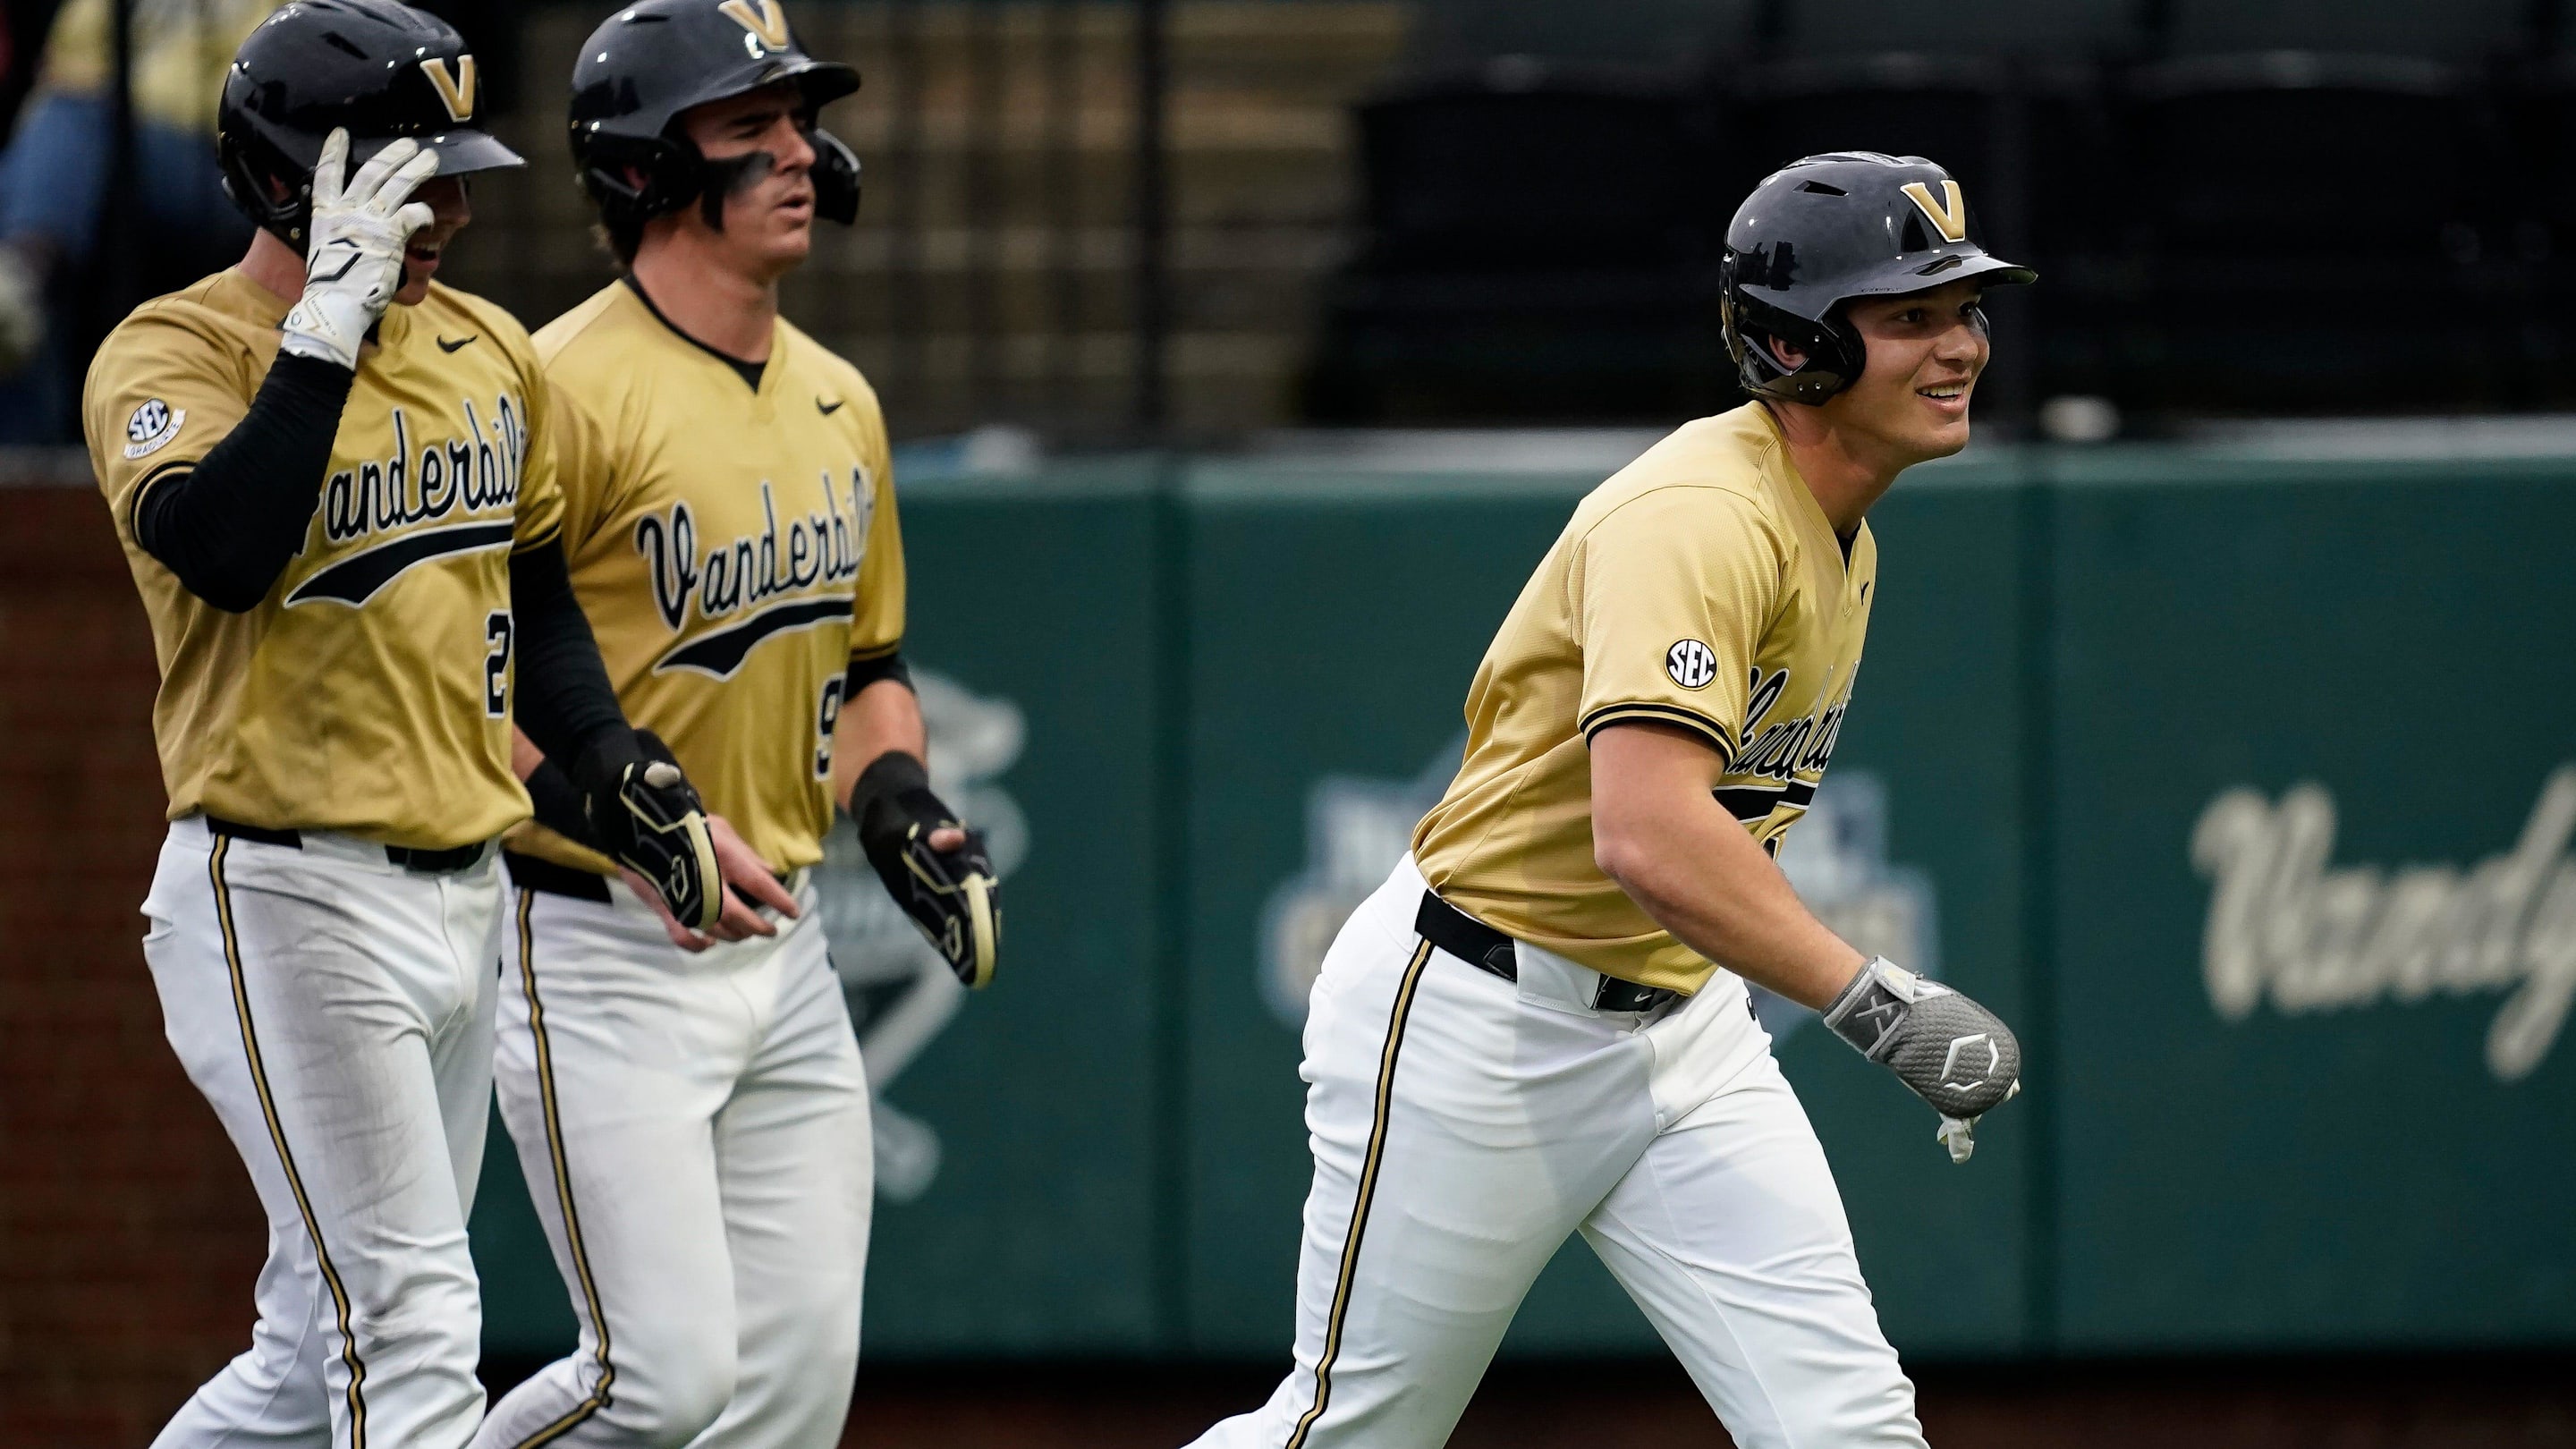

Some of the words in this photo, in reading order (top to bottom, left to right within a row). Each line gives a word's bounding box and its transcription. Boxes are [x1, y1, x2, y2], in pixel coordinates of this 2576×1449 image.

[717, 0, 789, 53] V
[419, 54, 475, 123] V
[1900, 179, 1966, 243] V
[128, 399, 168, 441] SEC
[301, 393, 526, 555] anderbil
[633, 462, 874, 631] Vanderbil
[1668, 640, 1716, 687] SEC
